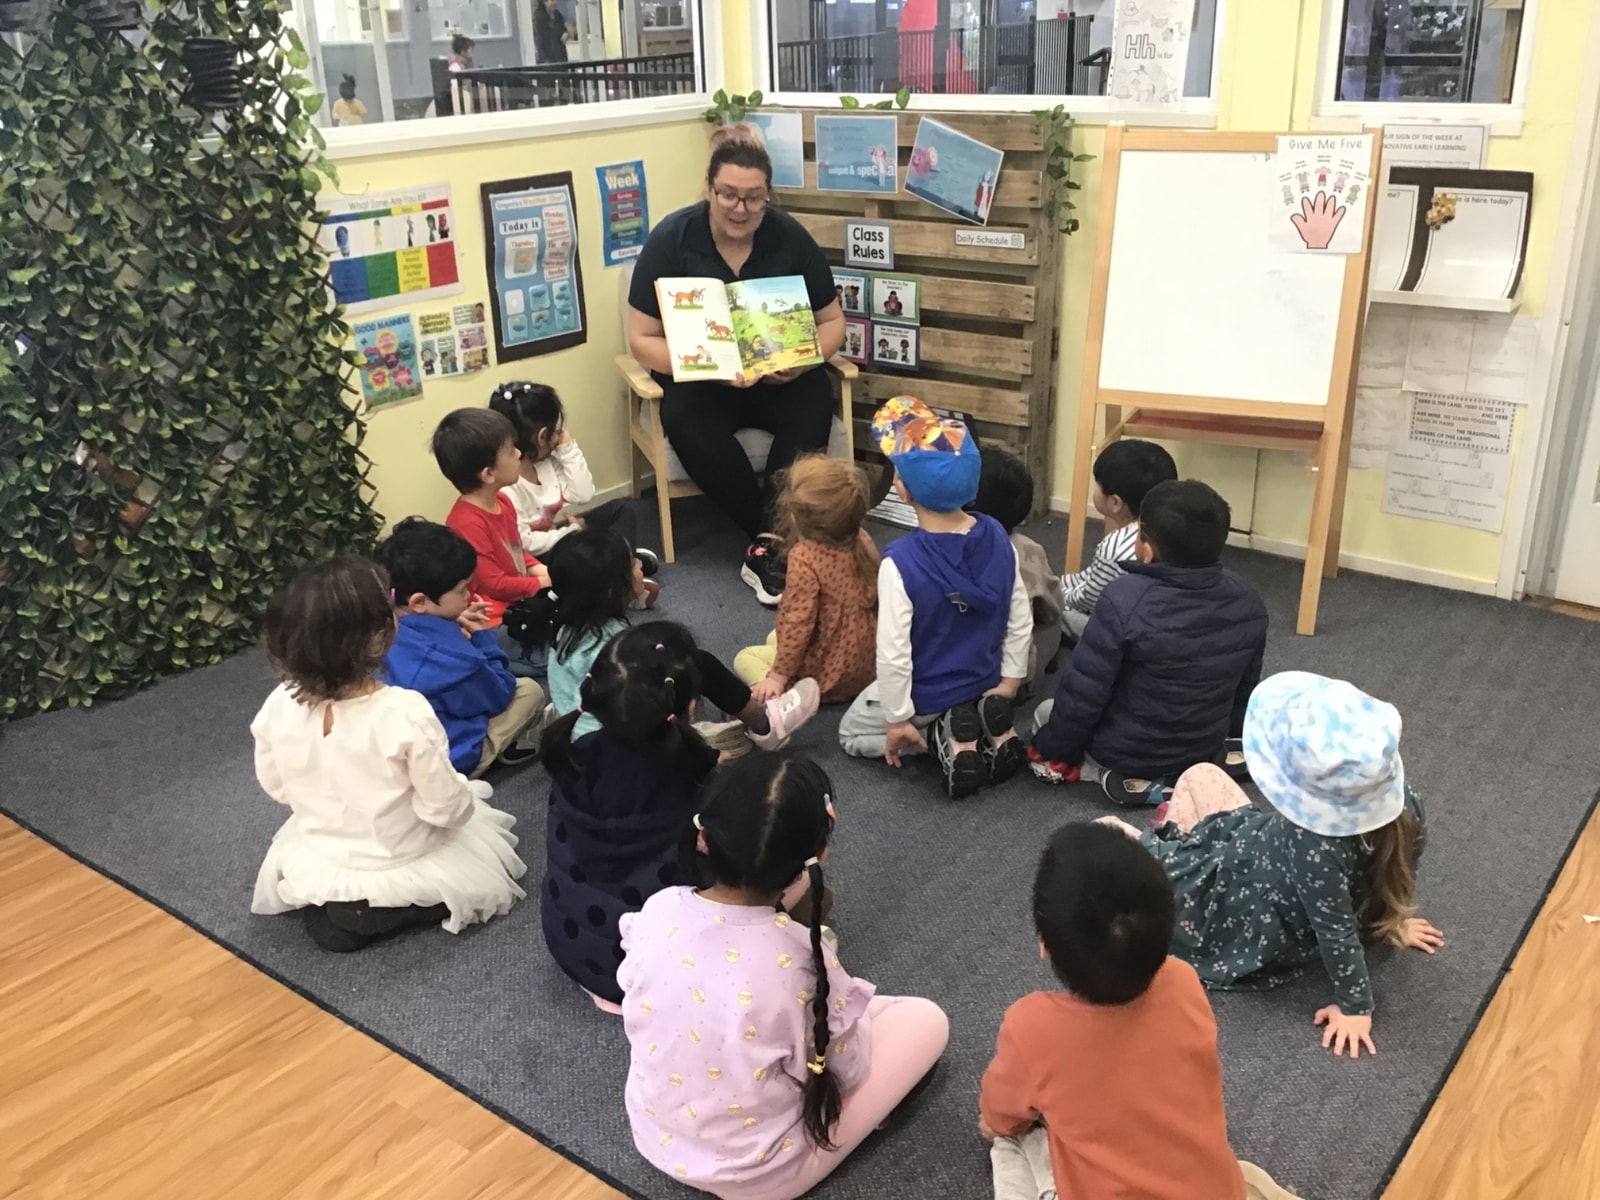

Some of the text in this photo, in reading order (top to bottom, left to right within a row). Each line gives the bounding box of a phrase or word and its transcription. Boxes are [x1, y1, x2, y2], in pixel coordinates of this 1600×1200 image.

[1124, 33, 1156, 60] Hh
[1289, 138, 1363, 150] Give Me Five
[1434, 144, 1467, 152] LEARNING
[605, 171, 640, 190] Week
[1471, 196, 1488, 204] here
[1490, 197, 1514, 206] today?
[502, 219, 539, 233] Today is
[852, 227, 884, 243] Class
[956, 234, 1009, 246] Daily Schedule
[853, 244, 885, 260] Rules
[354, 322, 377, 335] GOOD
[377, 314, 410, 329] MANNERS
